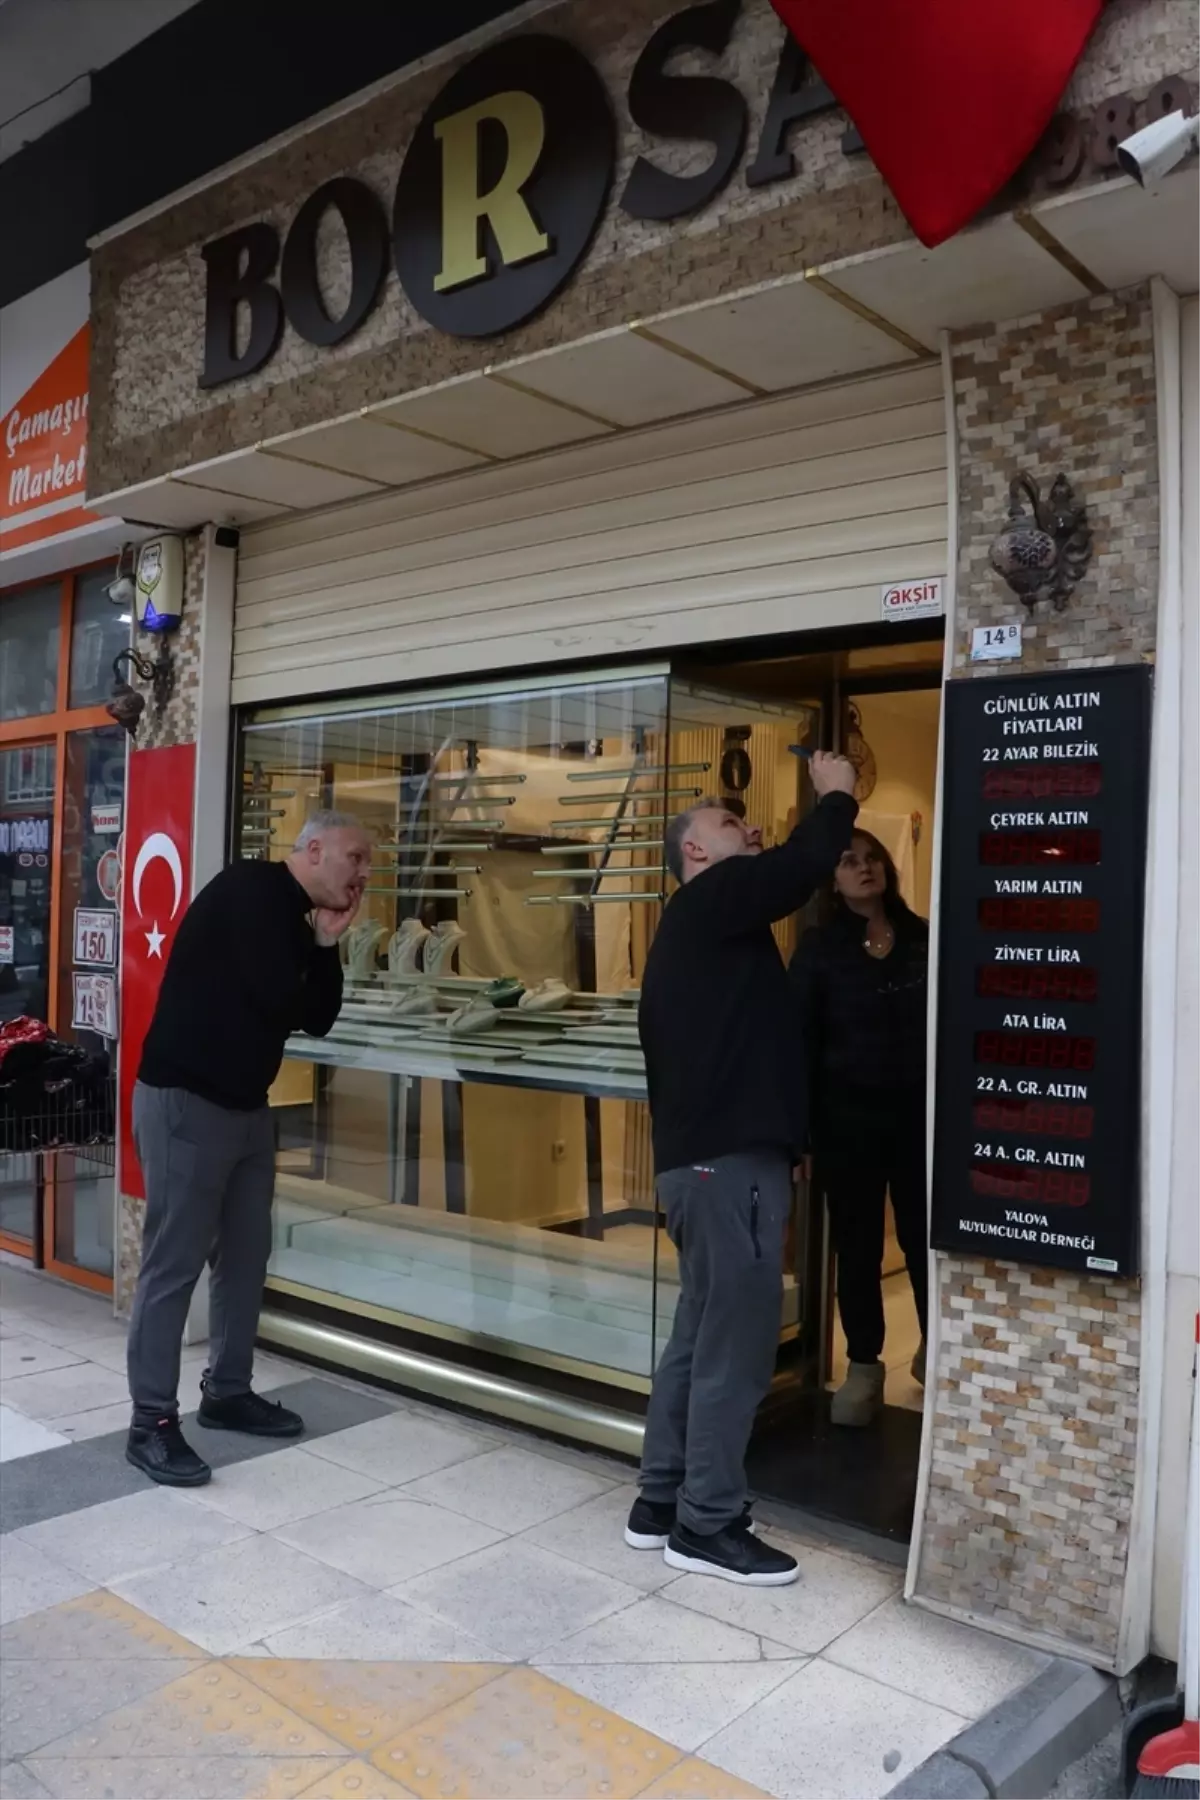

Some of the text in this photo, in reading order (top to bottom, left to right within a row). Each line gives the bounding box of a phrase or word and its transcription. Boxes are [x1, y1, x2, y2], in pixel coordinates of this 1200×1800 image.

[9, 444, 86, 506] Market
[983, 691, 1101, 715] GÜNLÜK ALTIN
[1003, 716, 1083, 735] FİYATLARI
[982, 748, 999, 761] 22
[1003, 746, 1039, 760] AYAR
[990, 811, 1089, 830] ÇEYREK ALTIN
[994, 879, 1082, 894] YARIM ALTIN
[80, 929, 106, 960] 150
[994, 944, 1081, 963] ZİYNET LİRA
[1002, 1013, 1067, 1031] ATA LİRA
[976, 1076, 1087, 1099] 22 A. GR. ALTIN
[974, 1143, 1086, 1168] 24 A. GR. ALTIN
[1004, 1209, 1049, 1226] YALOVA
[959, 1219, 1095, 1250] KUYUMCULAR DERNEĞİ
